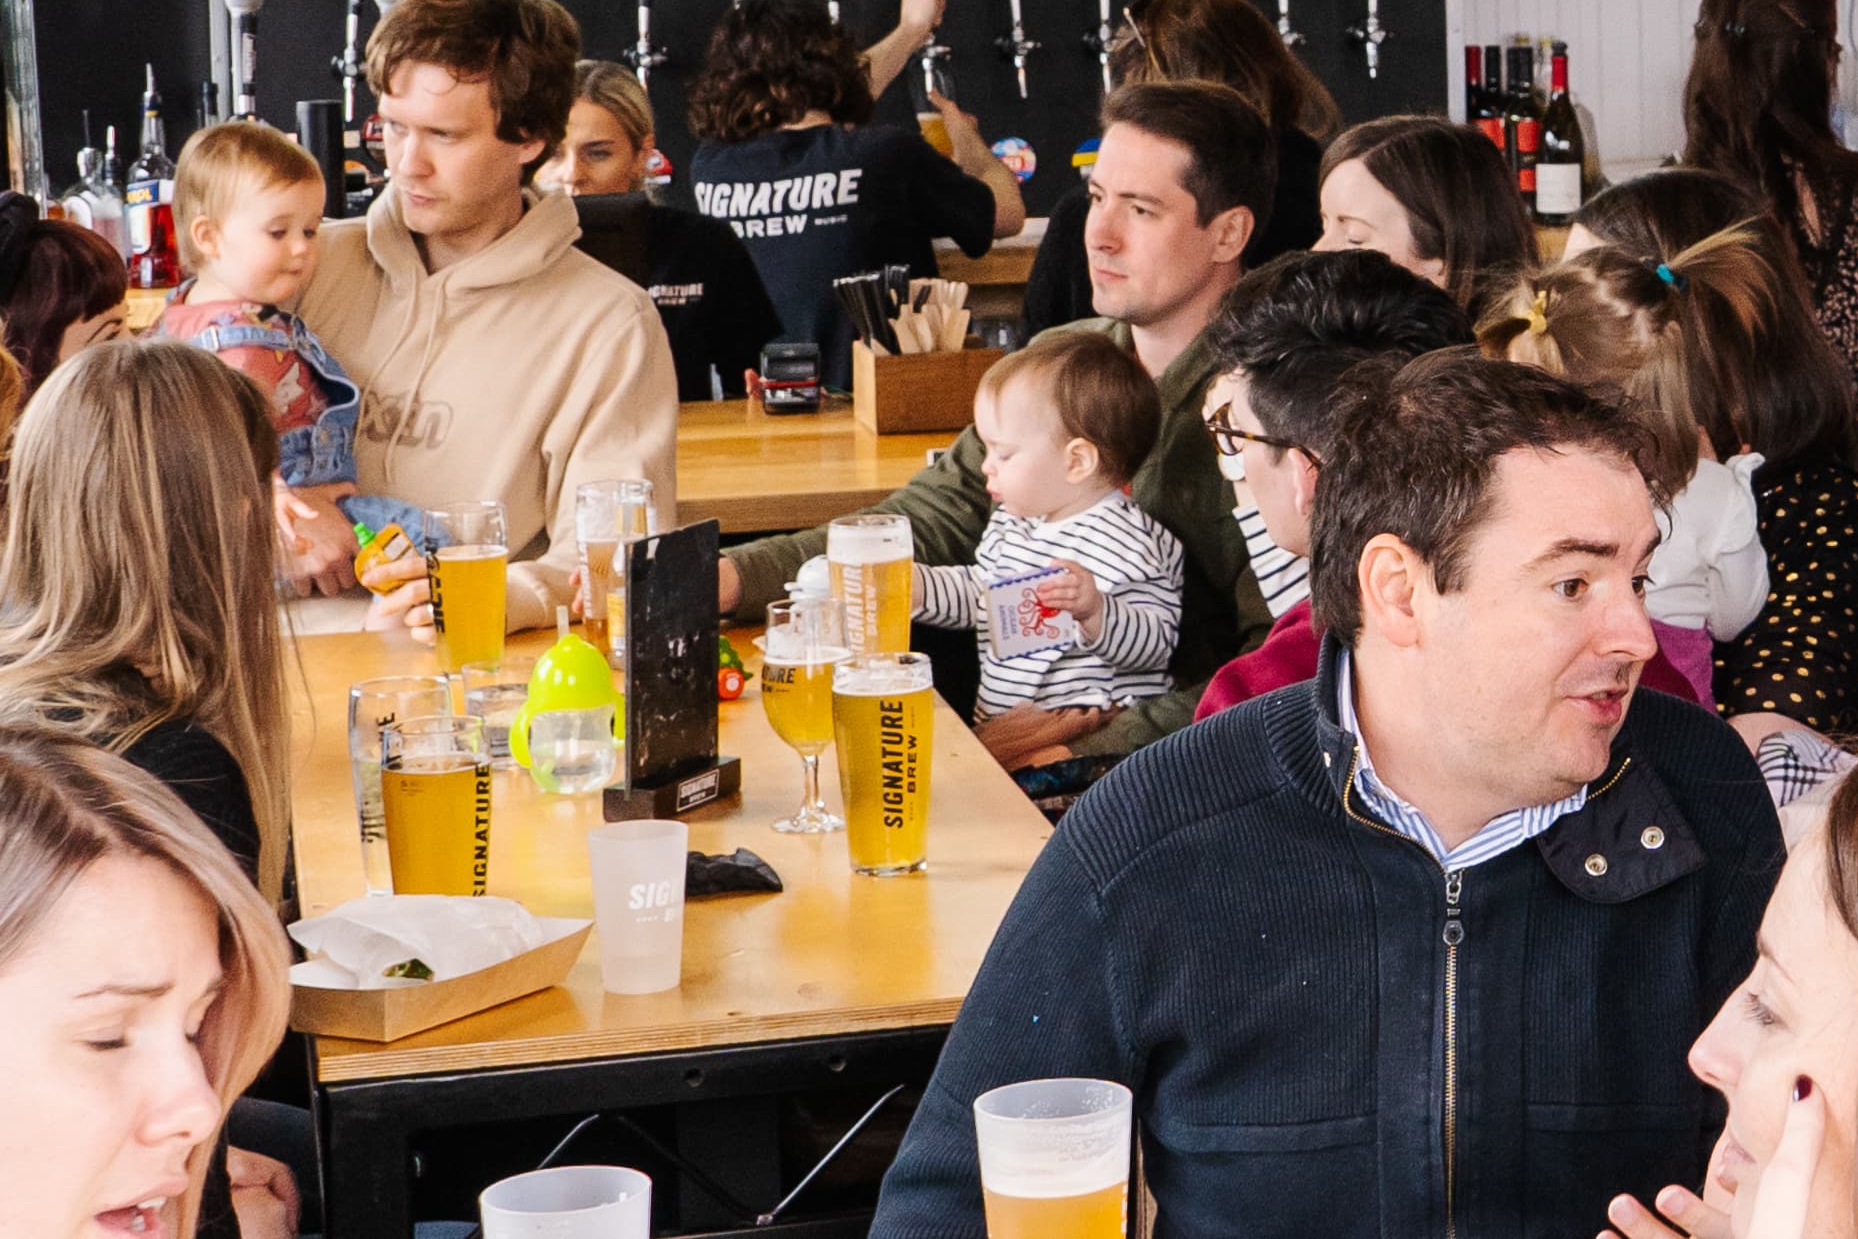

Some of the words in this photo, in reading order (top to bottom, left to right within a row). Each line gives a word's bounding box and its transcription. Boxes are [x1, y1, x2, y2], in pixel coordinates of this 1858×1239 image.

[694, 168, 863, 218] SIGNATURE
[879, 699, 904, 829] SIGNATURE
[907, 734, 918, 794] BREW
